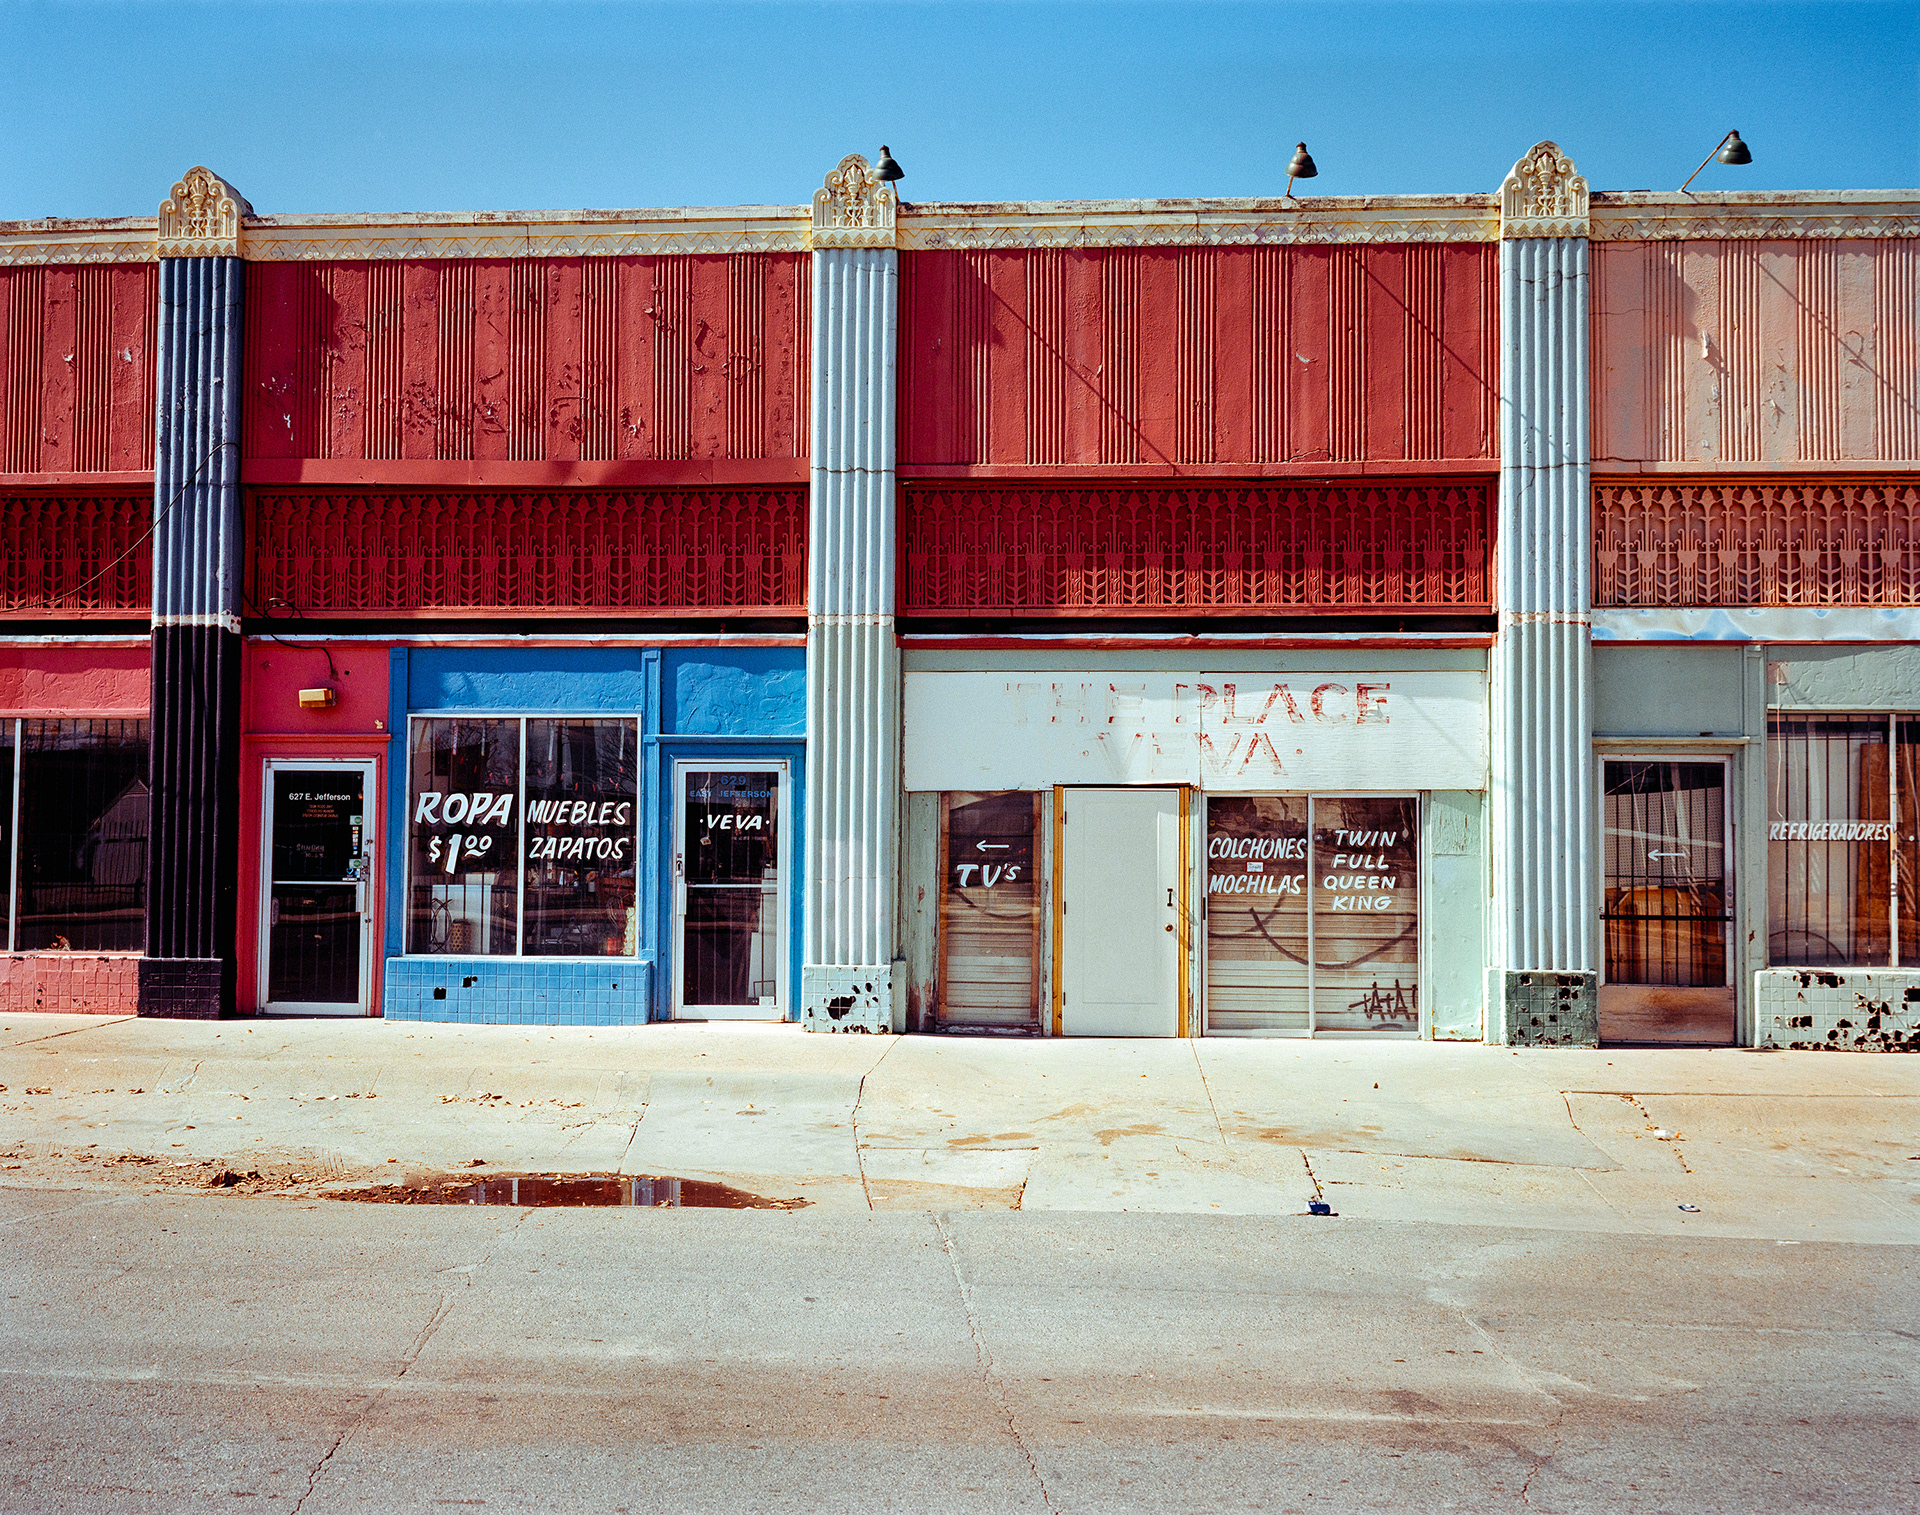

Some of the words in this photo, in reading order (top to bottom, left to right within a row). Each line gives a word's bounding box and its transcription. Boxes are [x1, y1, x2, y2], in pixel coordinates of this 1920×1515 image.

[1172, 682, 1391, 726] PLACE
[720, 775, 747, 786] 629
[288, 792, 304, 801] 627
[305, 792, 313, 801] E.
[314, 792, 351, 801] Jefferson
[689, 790, 713, 798] EAST
[717, 790, 773, 798] JEFFERSON
[414, 791, 514, 825] ROPA
[526, 799, 631, 825] MUEBLES
[707, 814, 762, 831] VEVA
[1769, 822, 1893, 841] REFRIGERADORES
[1335, 829, 1397, 847] TWIN
[528, 836, 630, 859] ZAPATOS
[1208, 837, 1308, 859] COLCHONES
[1332, 853, 1390, 869] FULL
[1208, 874, 1306, 895] MOCHILAS
[1323, 875, 1397, 890] QUEEN
[1332, 895, 1392, 911] KING
